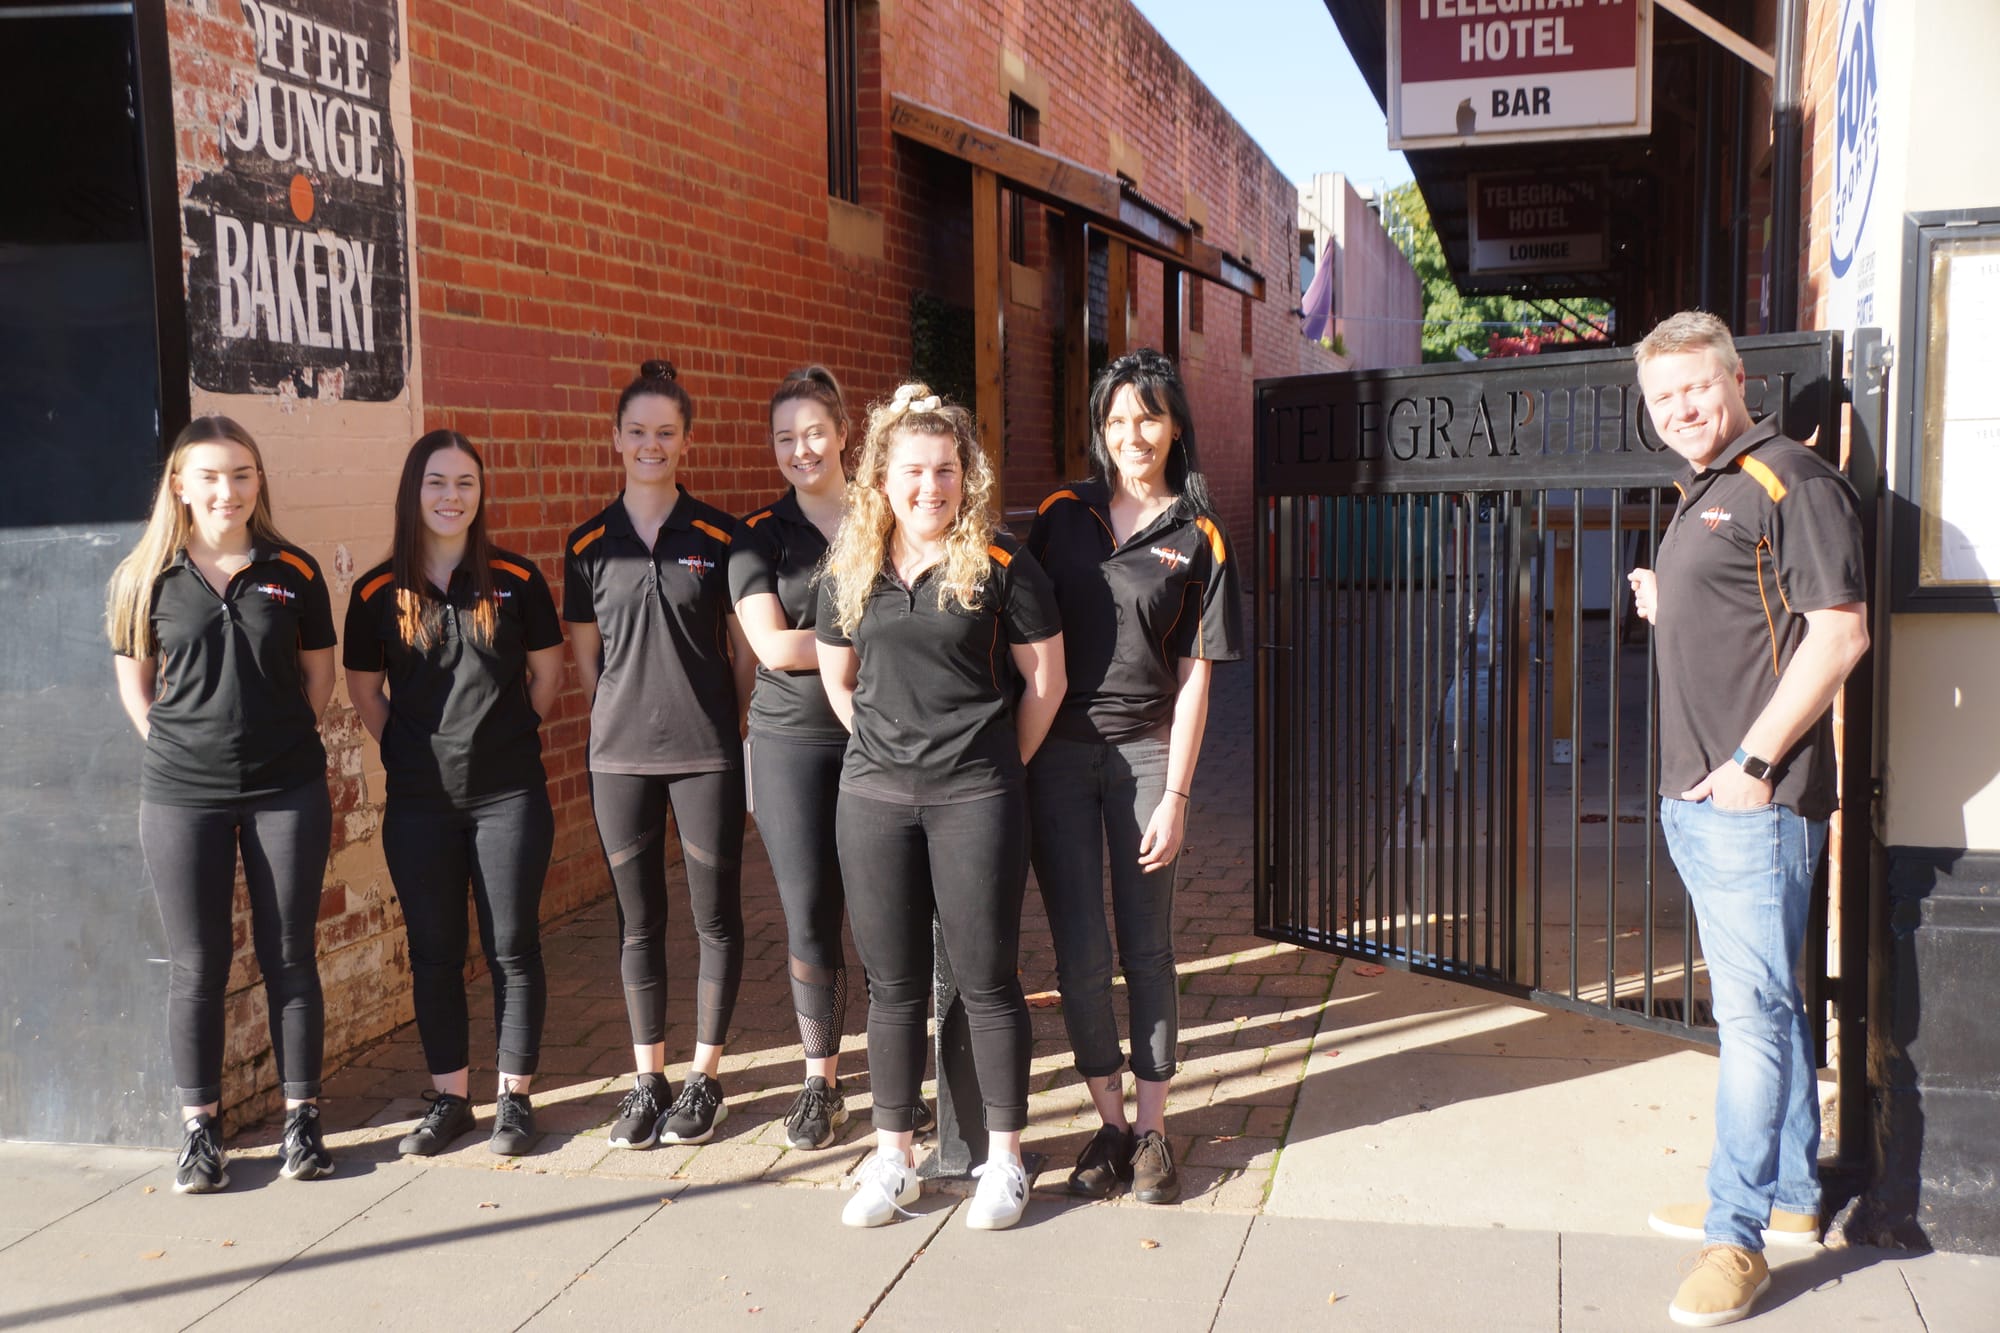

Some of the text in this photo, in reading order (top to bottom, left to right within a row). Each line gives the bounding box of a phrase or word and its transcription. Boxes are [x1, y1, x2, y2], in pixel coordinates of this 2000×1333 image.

[1460, 16, 1574, 63] HOTEL
[1491, 86, 1551, 118] BAR
[1837, 0, 1877, 197] FOX
[1836, 100, 1877, 239] SPORTS
[1508, 207, 1569, 231] HOTEL
[215, 214, 375, 353] BAKERY
[1509, 241, 1570, 262] LOUNGE
[1267, 384, 1579, 466] TELEGRAPH
